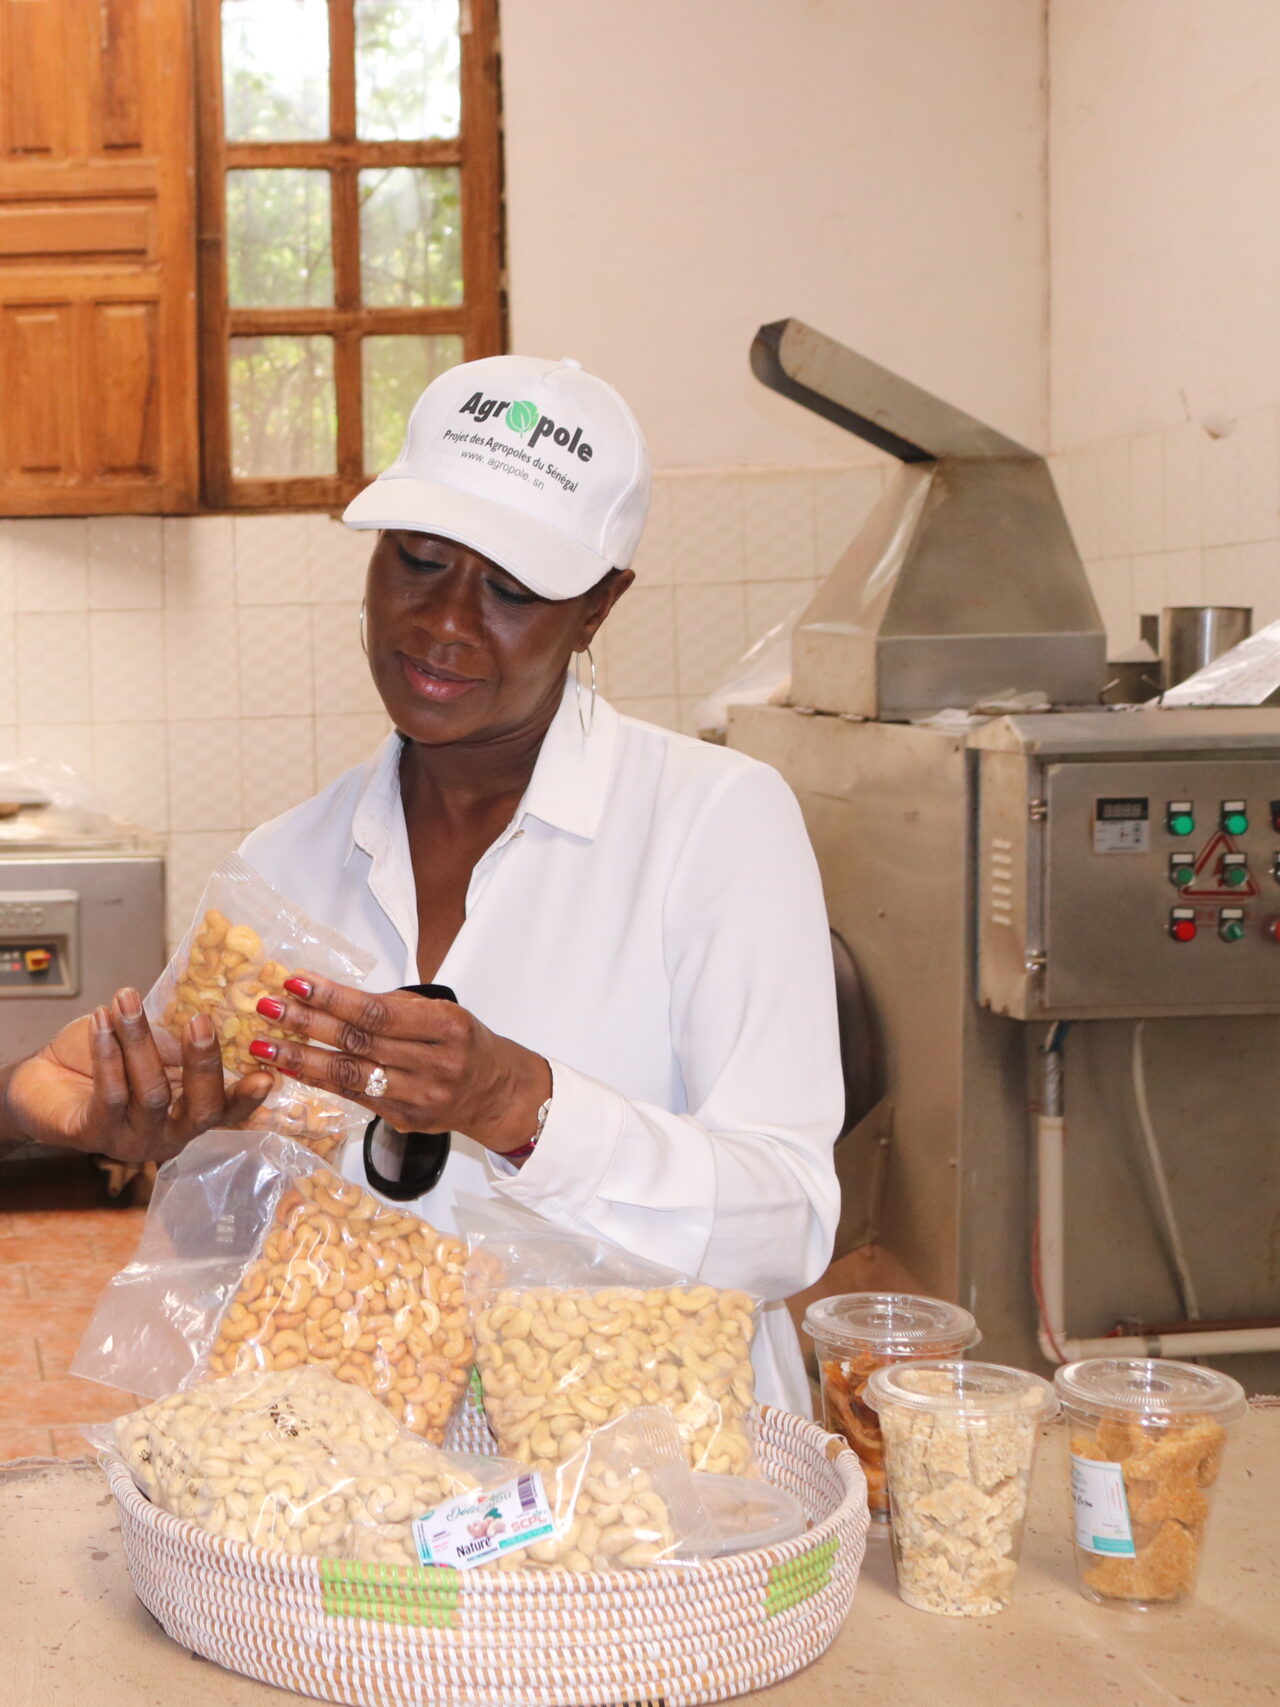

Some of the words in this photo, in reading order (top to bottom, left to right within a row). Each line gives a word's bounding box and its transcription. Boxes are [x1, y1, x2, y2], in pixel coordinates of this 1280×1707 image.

[442, 429, 469, 443] Projet
[469, 432, 485, 447] des
[485, 436, 532, 464] Agropoles
[532, 456, 546, 471] du
[545, 463, 579, 493] Sénégal
